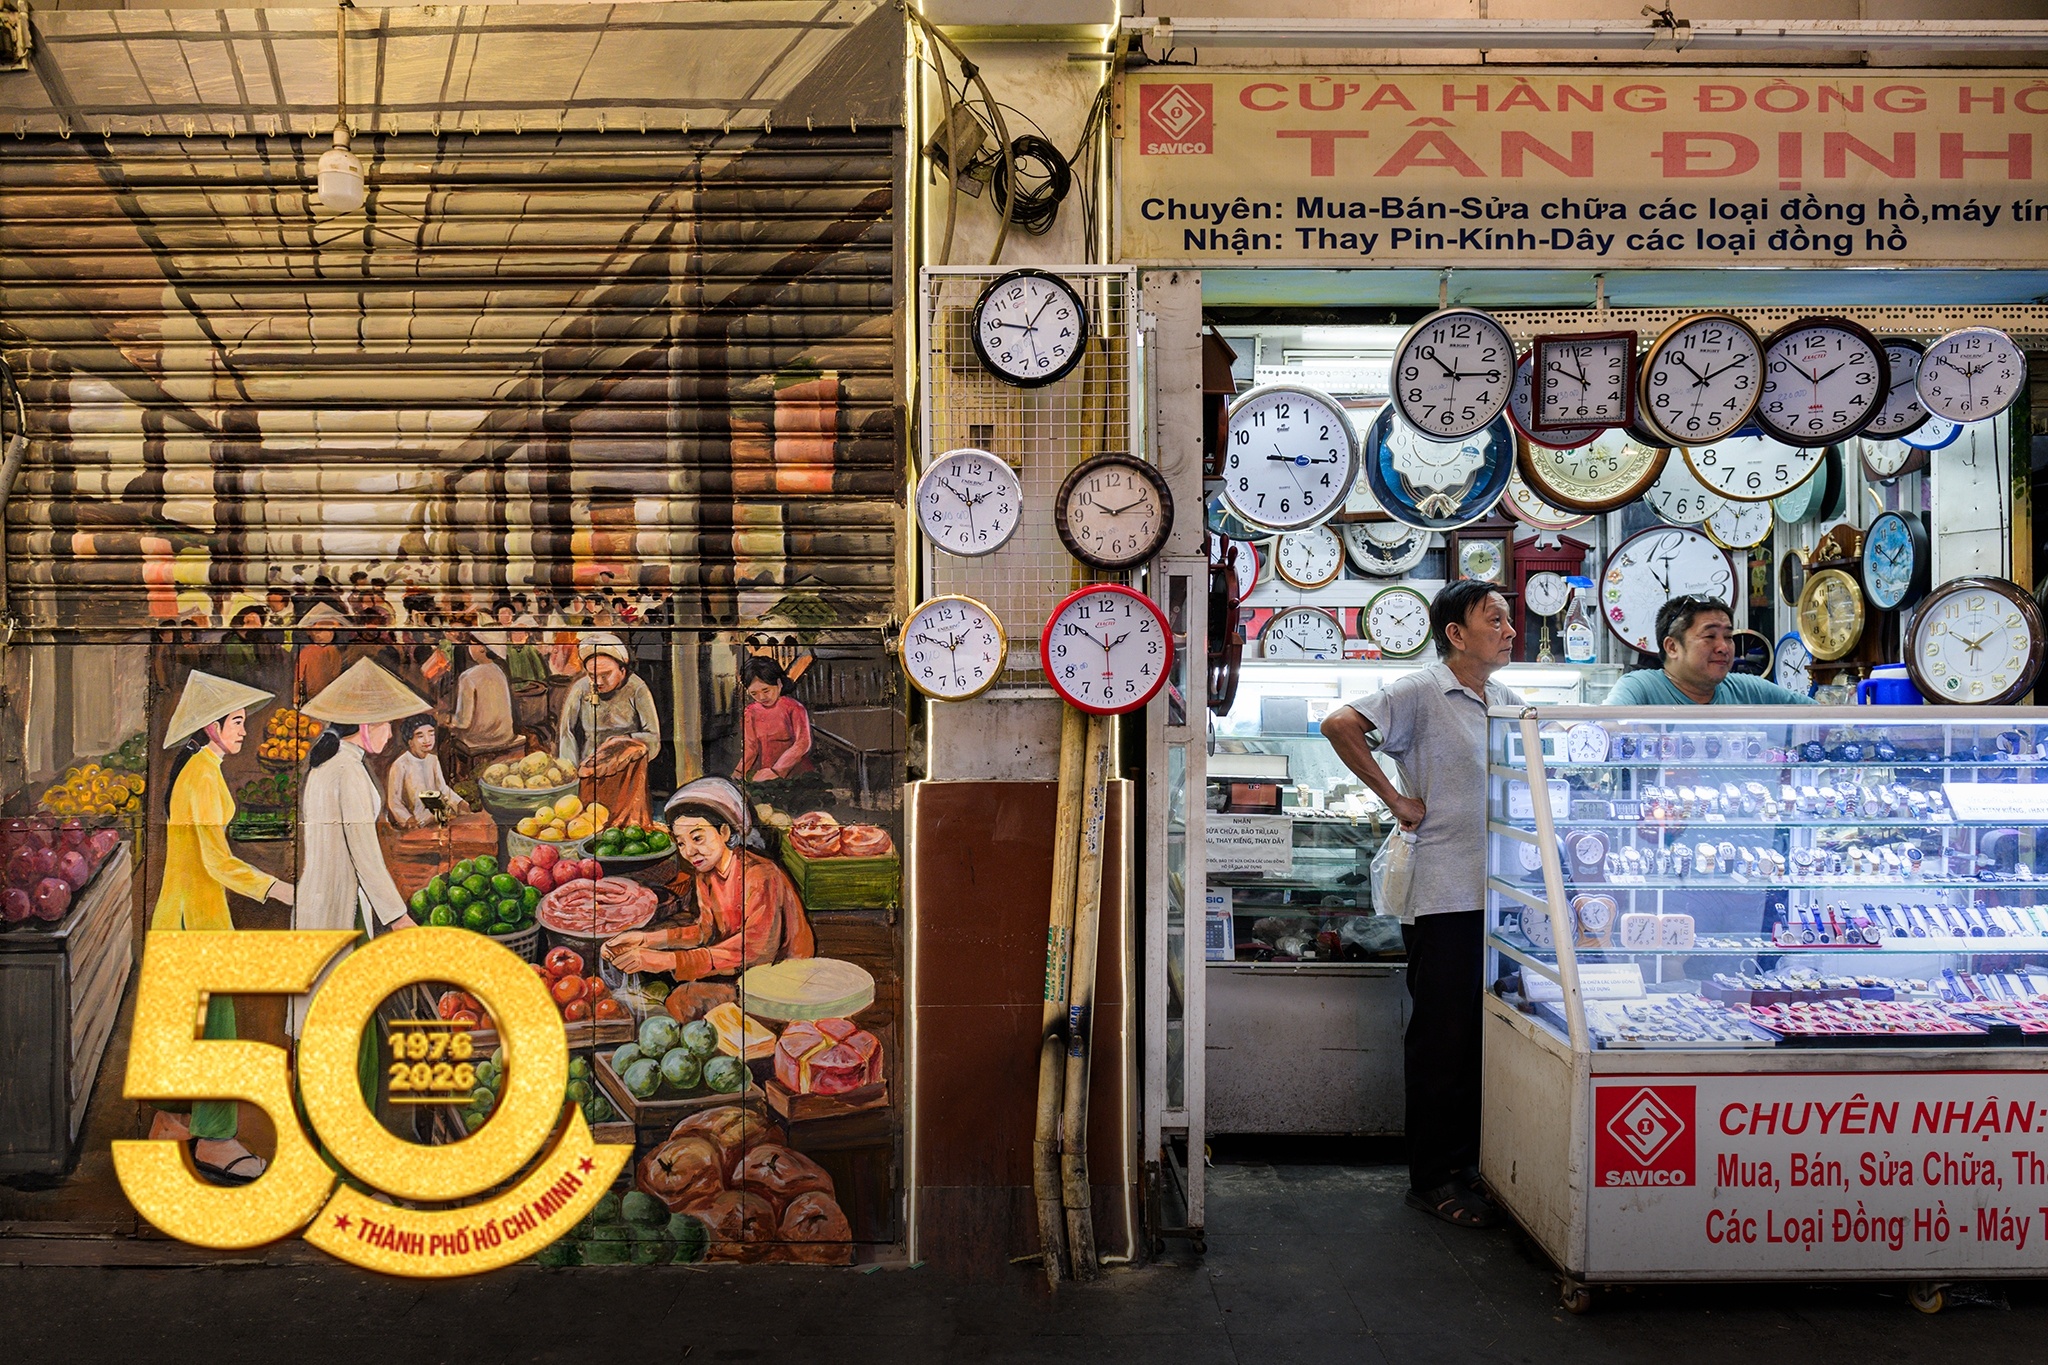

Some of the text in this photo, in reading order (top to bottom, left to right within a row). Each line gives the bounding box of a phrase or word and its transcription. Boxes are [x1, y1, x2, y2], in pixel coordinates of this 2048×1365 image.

[1239, 76, 1415, 113] CỬA
[1442, 77, 1667, 113] HÀNG
[1693, 77, 1927, 113] ĐỒNG
[1147, 142, 1206, 154] SAVICO
[1276, 116, 2032, 190] TÂN ĐỊNH
[1141, 197, 1282, 226] Chuyên:
[1297, 194, 1529, 220] Mua-Bán-Sửa
[1541, 198, 1626, 220] chữa
[1639, 198, 1697, 220] các
[1710, 198, 1767, 226] loại
[1781, 193, 1865, 227] đồng
[1184, 224, 1908, 257] Nhận: Thay Pin-Kính-Dây các loại đồng hồ
[1007, 287, 1024, 301] 12
[1031, 286, 1038, 296] 1
[994, 299, 1006, 311] 11
[1056, 308, 1069, 320] 3
[987, 318, 1001, 331] 10
[1451, 324, 1471, 338] 12
[1060, 328, 1071, 338] 4
[1433, 330, 1445, 343] 11
[1476, 331, 1482, 344] 1
[990, 337, 1001, 348] 9
[1053, 345, 1065, 356] 5
[1415, 346, 1434, 359] 10
[1482, 348, 1496, 362] 2
[1001, 352, 1012, 363] 8
[1039, 357, 1050, 368] 6
[1019, 359, 1029, 370] 7
[1405, 367, 1418, 381] 9
[1486, 369, 1500, 383] 3
[1409, 388, 1422, 402] 8
[1476, 391, 1490, 404] 4
[1275, 404, 1289, 418] 12
[1304, 409, 1310, 423] 1
[1422, 405, 1436, 418] 7
[1462, 406, 1475, 420] 5
[1253, 412, 1264, 426] 11
[1441, 411, 1454, 425] 6
[1235, 431, 1249, 444] 10
[1320, 426, 1328, 440] 2
[1230, 455, 1239, 468] 9
[1329, 450, 1338, 462] 3
[1239, 478, 1249, 491] 8
[1320, 473, 1330, 487] 4
[1257, 494, 1265, 507] 7
[1303, 492, 1313, 505] 5
[1281, 499, 1289, 512] 6
[1078, 606, 1089, 619] 11
[1098, 600, 1114, 613] 12
[1124, 605, 1131, 617] 1
[1063, 623, 1077, 636] 10
[1140, 621, 1149, 632] 2
[1057, 645, 1066, 656] 9
[1147, 642, 1157, 653] 3
[1065, 667, 1074, 678] 8
[1140, 664, 1150, 675] 4
[1082, 682, 1091, 693] 7
[1104, 687, 1113, 698] 6
[1125, 680, 1135, 692] 5
[1720, 1094, 2048, 1141] CHUYÊN NHẬN:
[1605, 1169, 1686, 1186] SAVICO
[1718, 1151, 2048, 1193] Mua, Bán, Sửa Chữa, Th
[1706, 1209, 1757, 1243] Các
[1767, 1210, 1824, 1251] Loại
[1832, 1202, 1903, 1251] Đồng
[1914, 1201, 1950, 1241] Hồ
[1977, 1207, 2030, 1250] Máy
